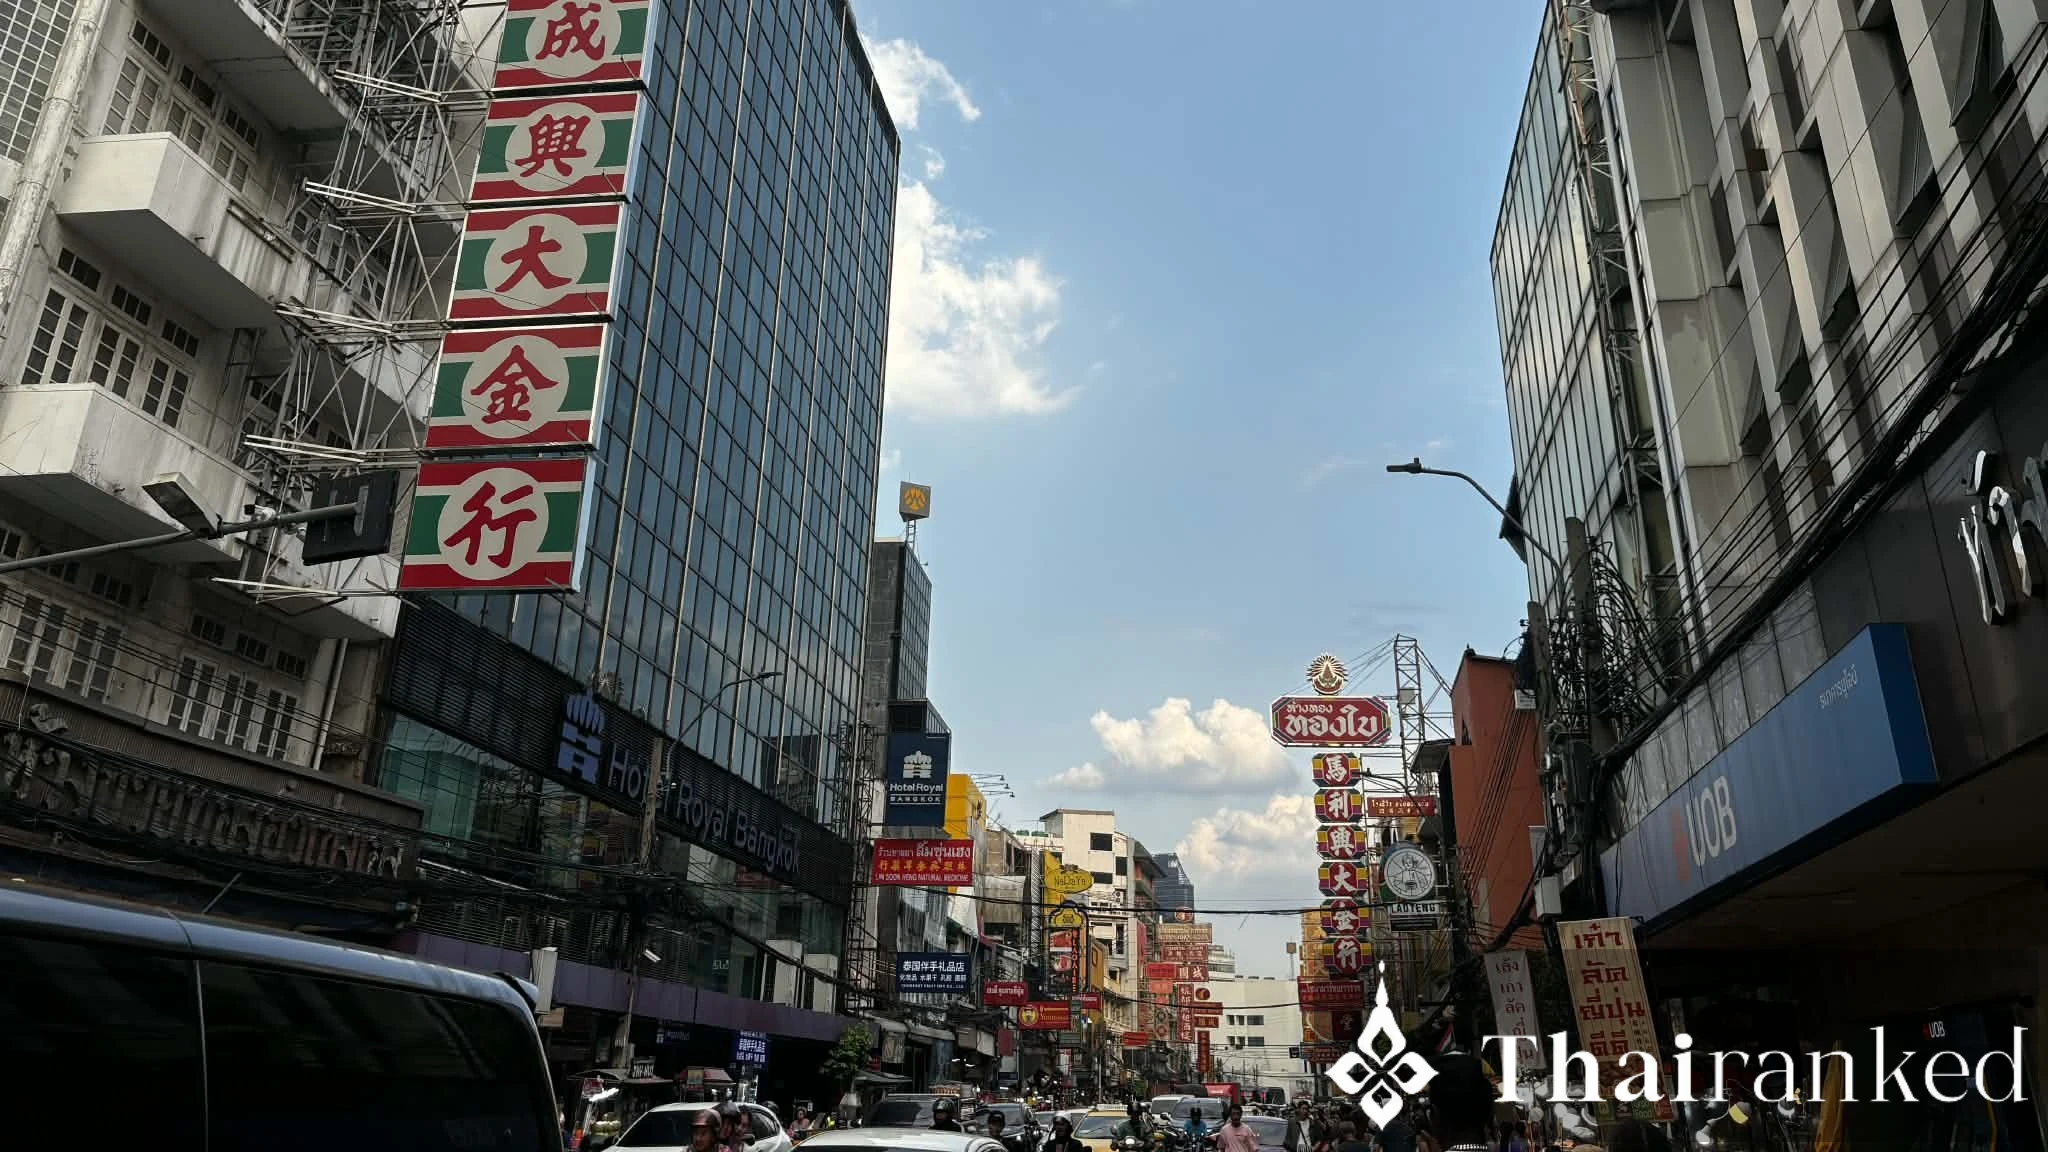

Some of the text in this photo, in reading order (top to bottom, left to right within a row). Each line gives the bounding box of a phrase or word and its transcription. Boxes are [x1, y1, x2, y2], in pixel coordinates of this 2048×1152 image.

[1286, 701, 1333, 713] ห้างทอง
[889, 783, 944, 793] Hotel Royal
[676, 779, 731, 842] Royal
[734, 808, 800, 873] Bangkok
[1685, 775, 1737, 867] UOB
[903, 960, 965, 972] 泰国伴手礼品店
[1928, 1020, 1946, 1039] UOB
